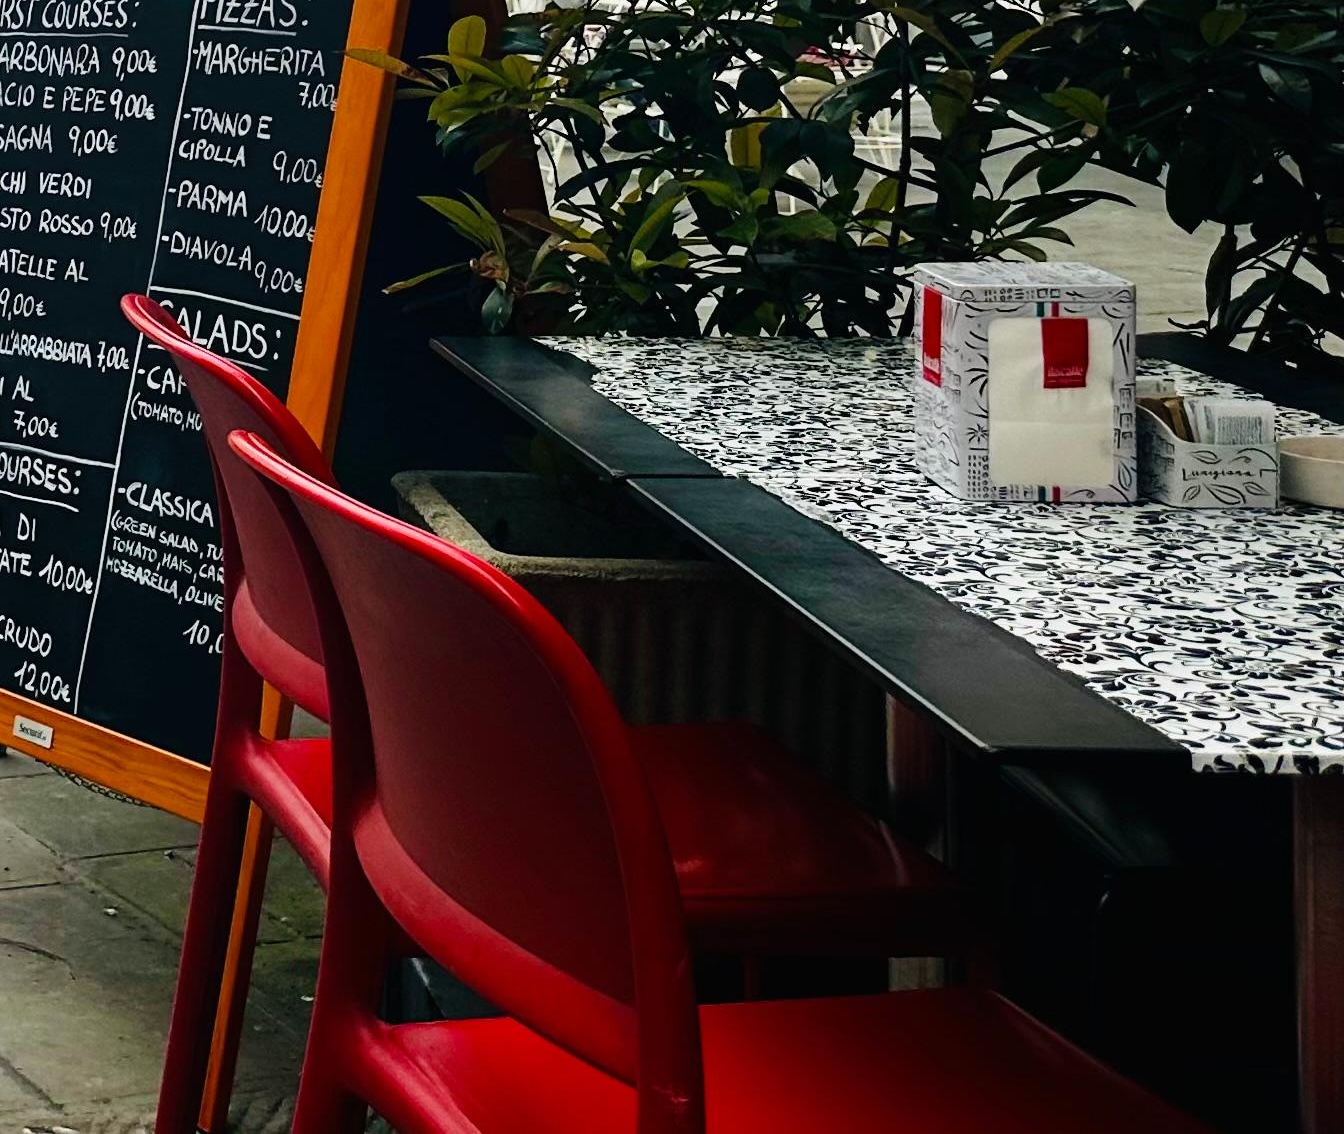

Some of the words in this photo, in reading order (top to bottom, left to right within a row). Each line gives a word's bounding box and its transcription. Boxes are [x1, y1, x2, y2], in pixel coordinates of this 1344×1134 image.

[112, 47, 157, 81] 9,00€
[43, 87, 55, 109] E
[62, 86, 106, 113] PEPE
[69, 126, 118, 156] 9,00€
[257, 116, 272, 139] E
[178, 139, 245, 167] CIPOLLA
[39, 172, 92, 199] VERDI
[39, 209, 94, 236] ROSSO
[100, 212, 137, 243] 9,00€
[64, 259, 89, 282] AL
[12, 375, 34, 402] AL
[13, 409, 59, 439] 7,00€
[16, 512, 36, 542] DI
[13, 660, 71, 703] 12,00€
